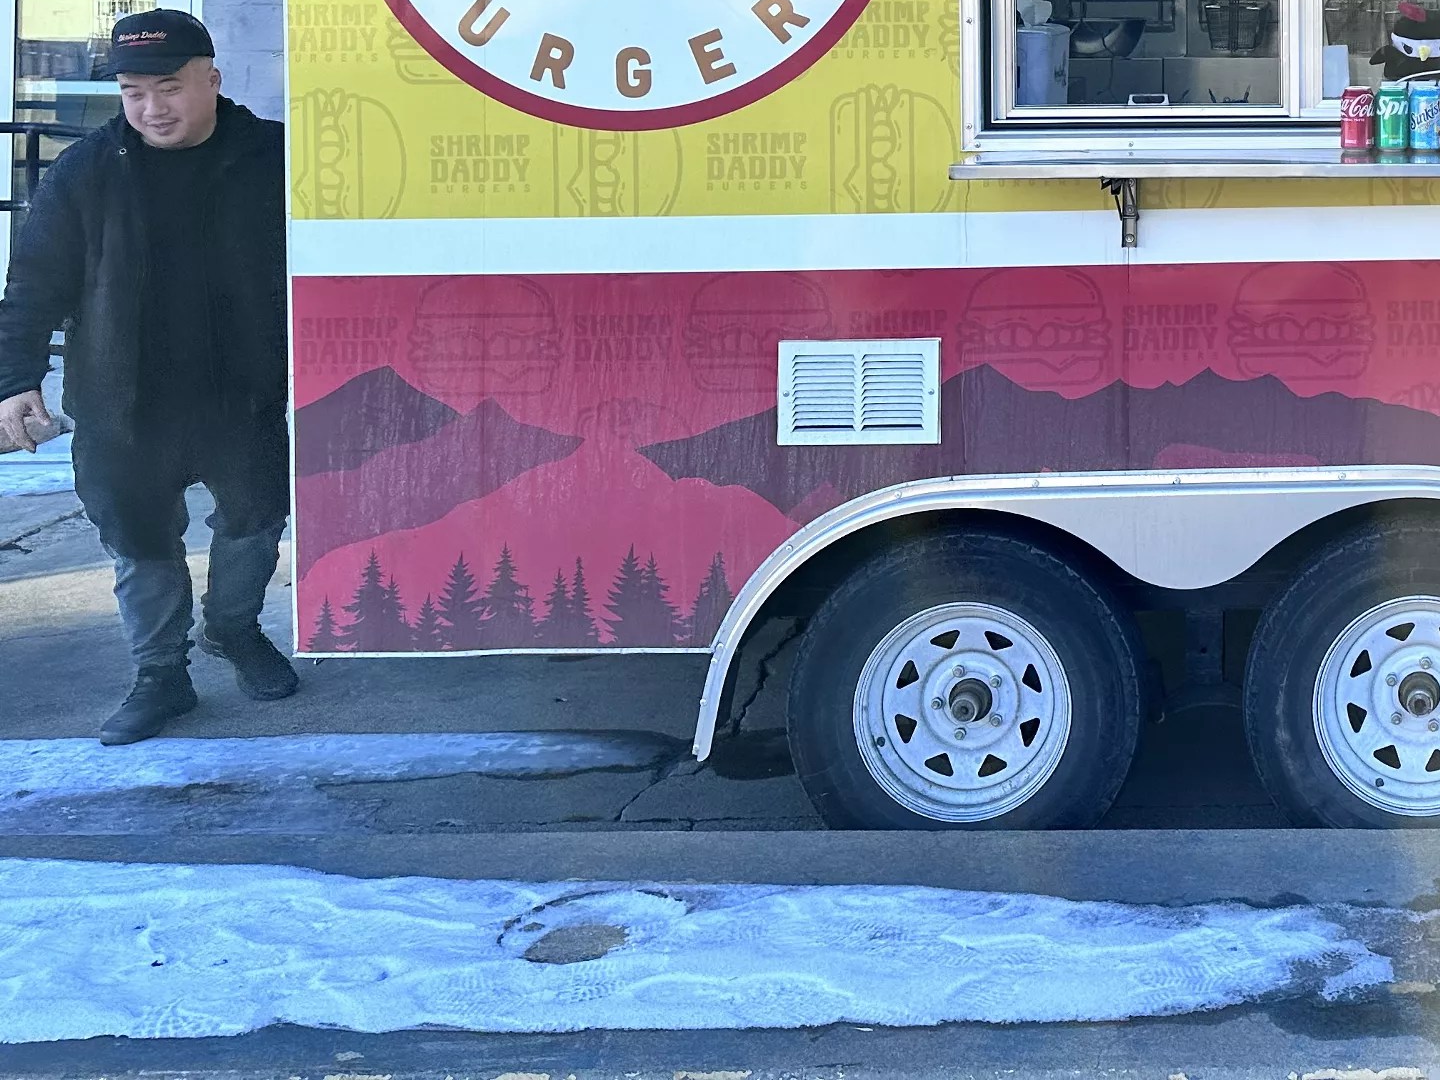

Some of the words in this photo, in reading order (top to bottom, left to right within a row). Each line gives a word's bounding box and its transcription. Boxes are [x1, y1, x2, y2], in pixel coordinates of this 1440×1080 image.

[430, 134, 530, 157] SHRIMP
[707, 132, 807, 155] SHRIMP
[430, 158, 531, 182] DADDY
[707, 155, 807, 180] DADDY
